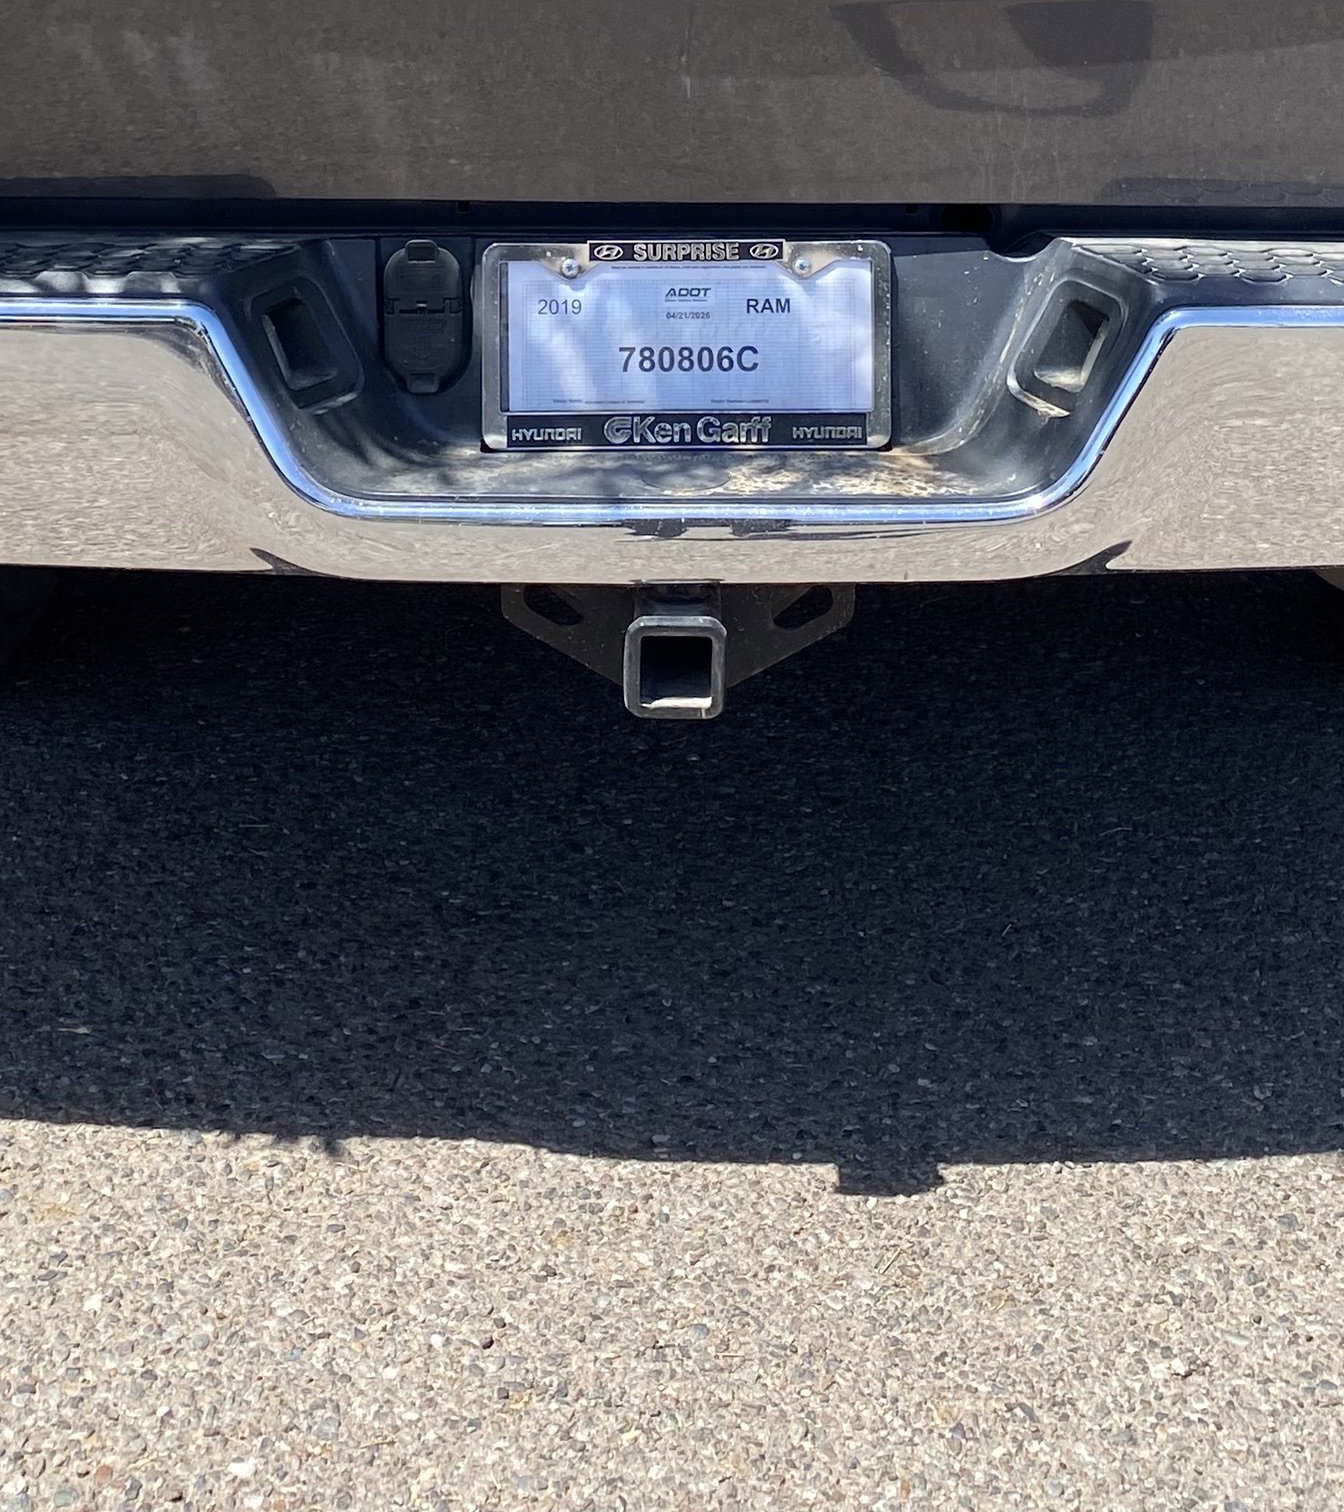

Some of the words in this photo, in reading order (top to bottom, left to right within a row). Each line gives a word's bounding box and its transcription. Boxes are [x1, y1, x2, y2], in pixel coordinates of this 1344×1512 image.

[633, 243, 740, 261] SURPRISE
[665, 288, 711, 298] ADOT
[537, 299, 582, 315] 2019
[746, 299, 791, 314] RAM
[618, 346, 759, 373] 780806C
[512, 428, 582, 441] HYUNDAI
[633, 416, 692, 443] Ken
[697, 416, 771, 444] Garff
[792, 426, 863, 439] HYUNDAI
